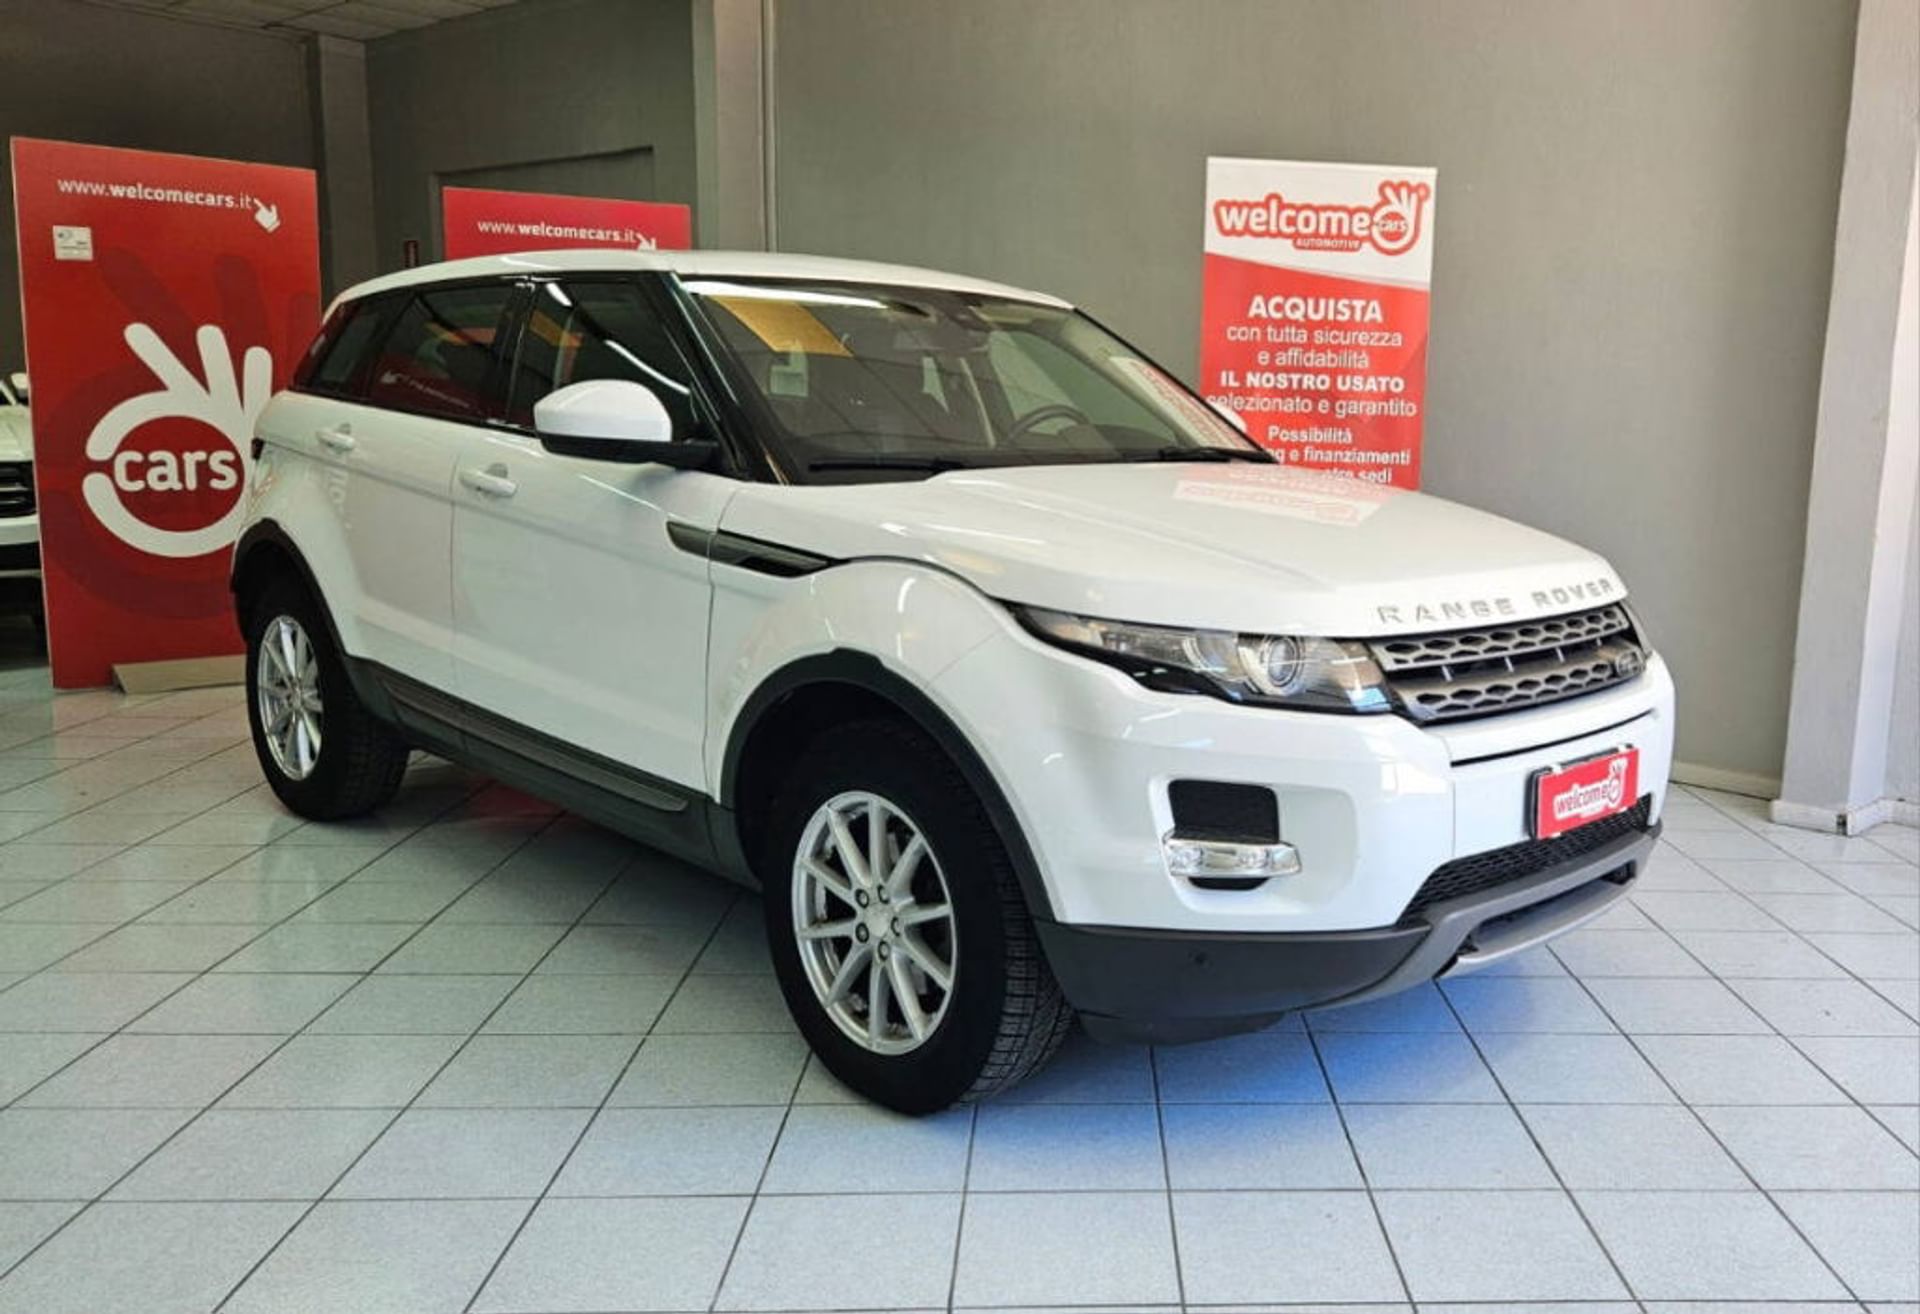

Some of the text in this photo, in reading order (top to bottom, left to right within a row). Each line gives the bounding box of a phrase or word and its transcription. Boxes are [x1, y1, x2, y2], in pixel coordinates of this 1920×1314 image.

[57, 178, 252, 210] www.welcomecars.it
[1217, 197, 1407, 235] welcome cars
[477, 221, 636, 244] www.welcomecars.it
[1295, 237, 1361, 250] AUTOMOTIVE
[1248, 296, 1384, 324] ACQUISTA
[1226, 325, 1403, 348] con tutta sicurezza
[1257, 347, 1370, 369] e affidabilità
[1220, 370, 1405, 393] IL NOSTRO USATO
[1318, 399, 1330, 414] e
[1335, 398, 1418, 419] garantito
[1268, 425, 1353, 444] Possibilità
[1289, 449, 1300, 463] e
[1303, 448, 1412, 466] finanziamenti
[114, 449, 238, 493] cars
[1377, 578, 1613, 625] RANGE ROVER
[1556, 785, 1610, 813] welcome
